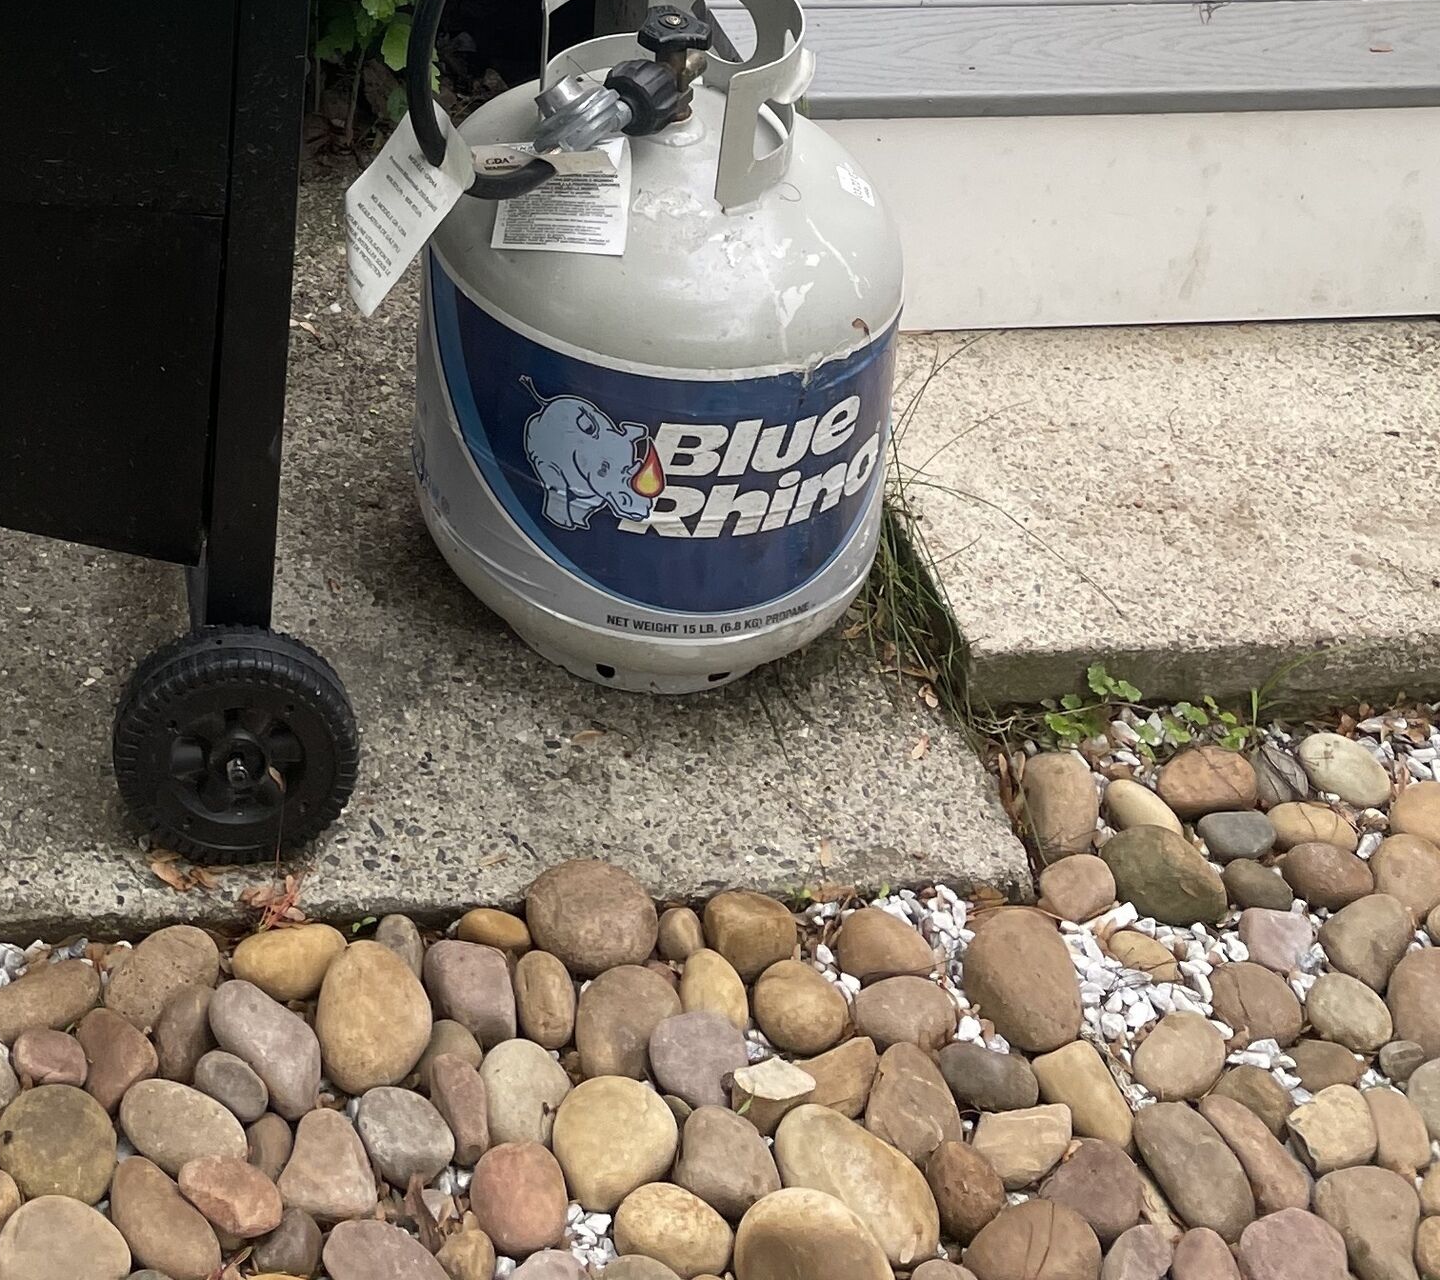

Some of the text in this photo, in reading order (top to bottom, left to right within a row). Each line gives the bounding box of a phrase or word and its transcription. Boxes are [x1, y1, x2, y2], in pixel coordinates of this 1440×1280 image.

[656, 395, 861, 478] Blue
[617, 432, 881, 539] Rhino
[606, 614, 630, 628] NET
[632, 619, 679, 634] WEIGHT
[682, 624, 696, 634] 15
[720, 621, 742, 634] (6.8
[744, 618, 763, 630] KG)
